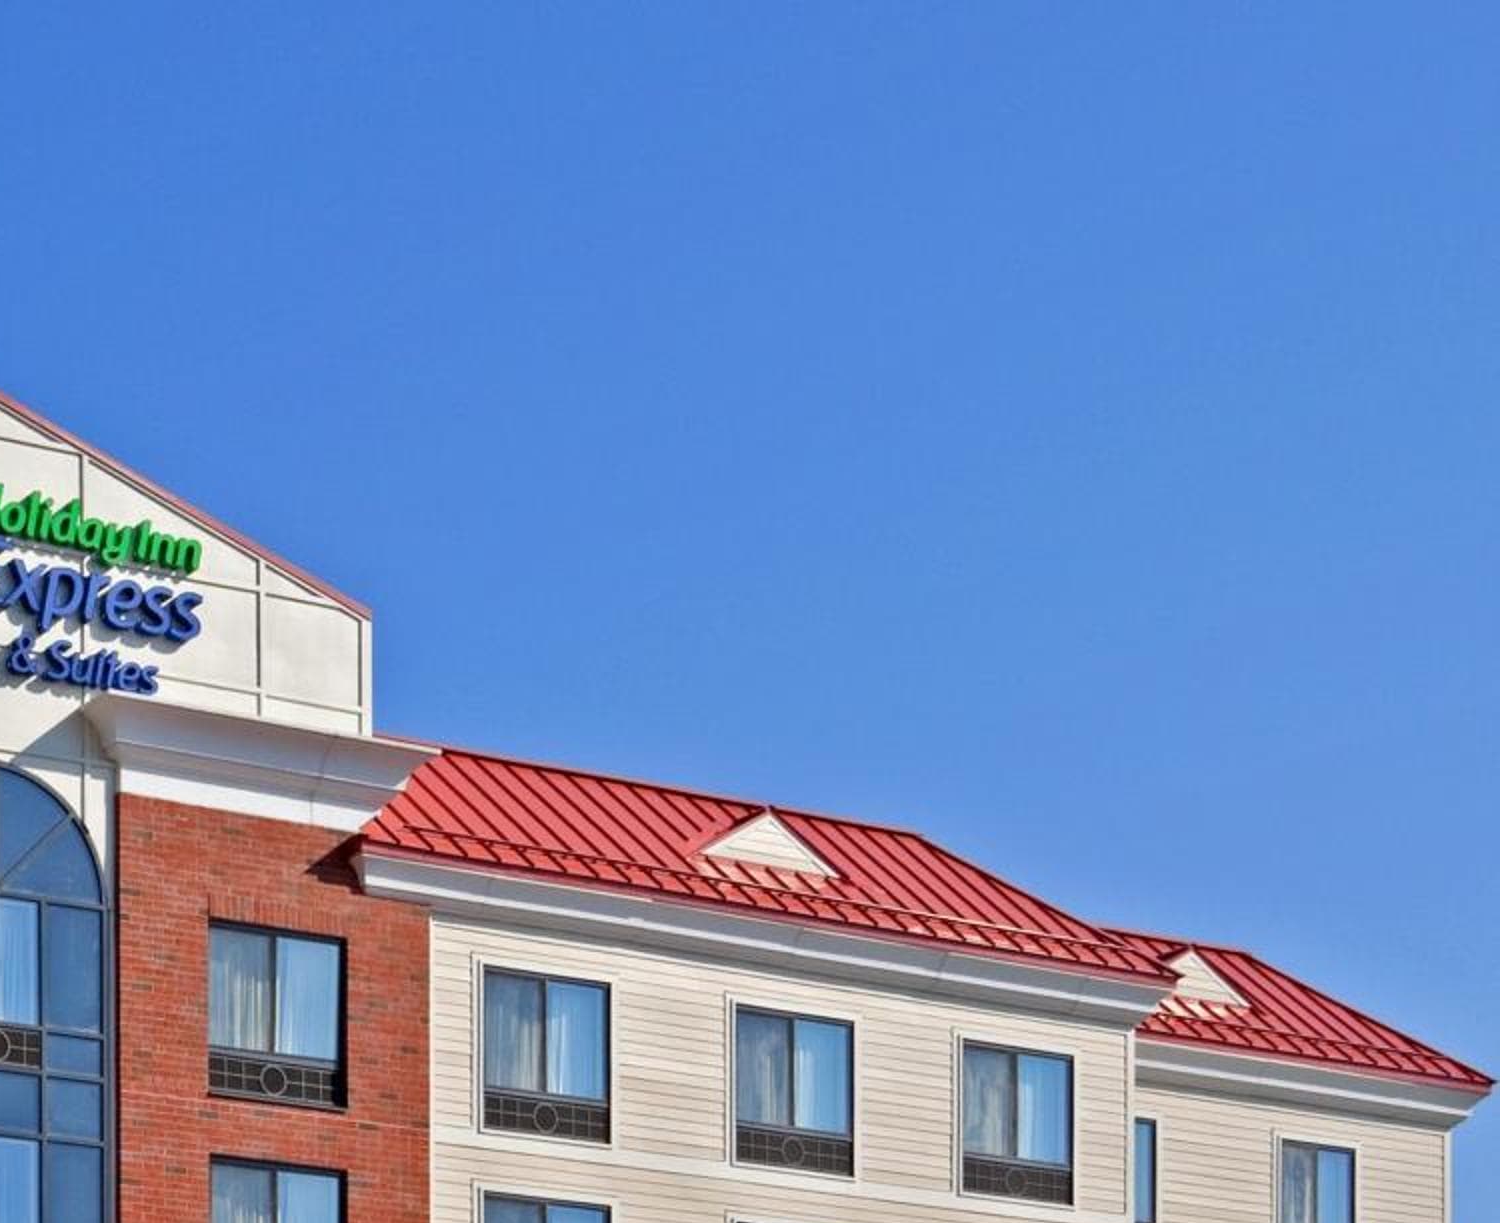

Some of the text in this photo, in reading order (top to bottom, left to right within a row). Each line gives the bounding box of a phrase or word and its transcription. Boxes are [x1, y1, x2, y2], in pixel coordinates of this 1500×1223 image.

[133, 519, 202, 574] Inn
[7, 634, 159, 695] & Suites
